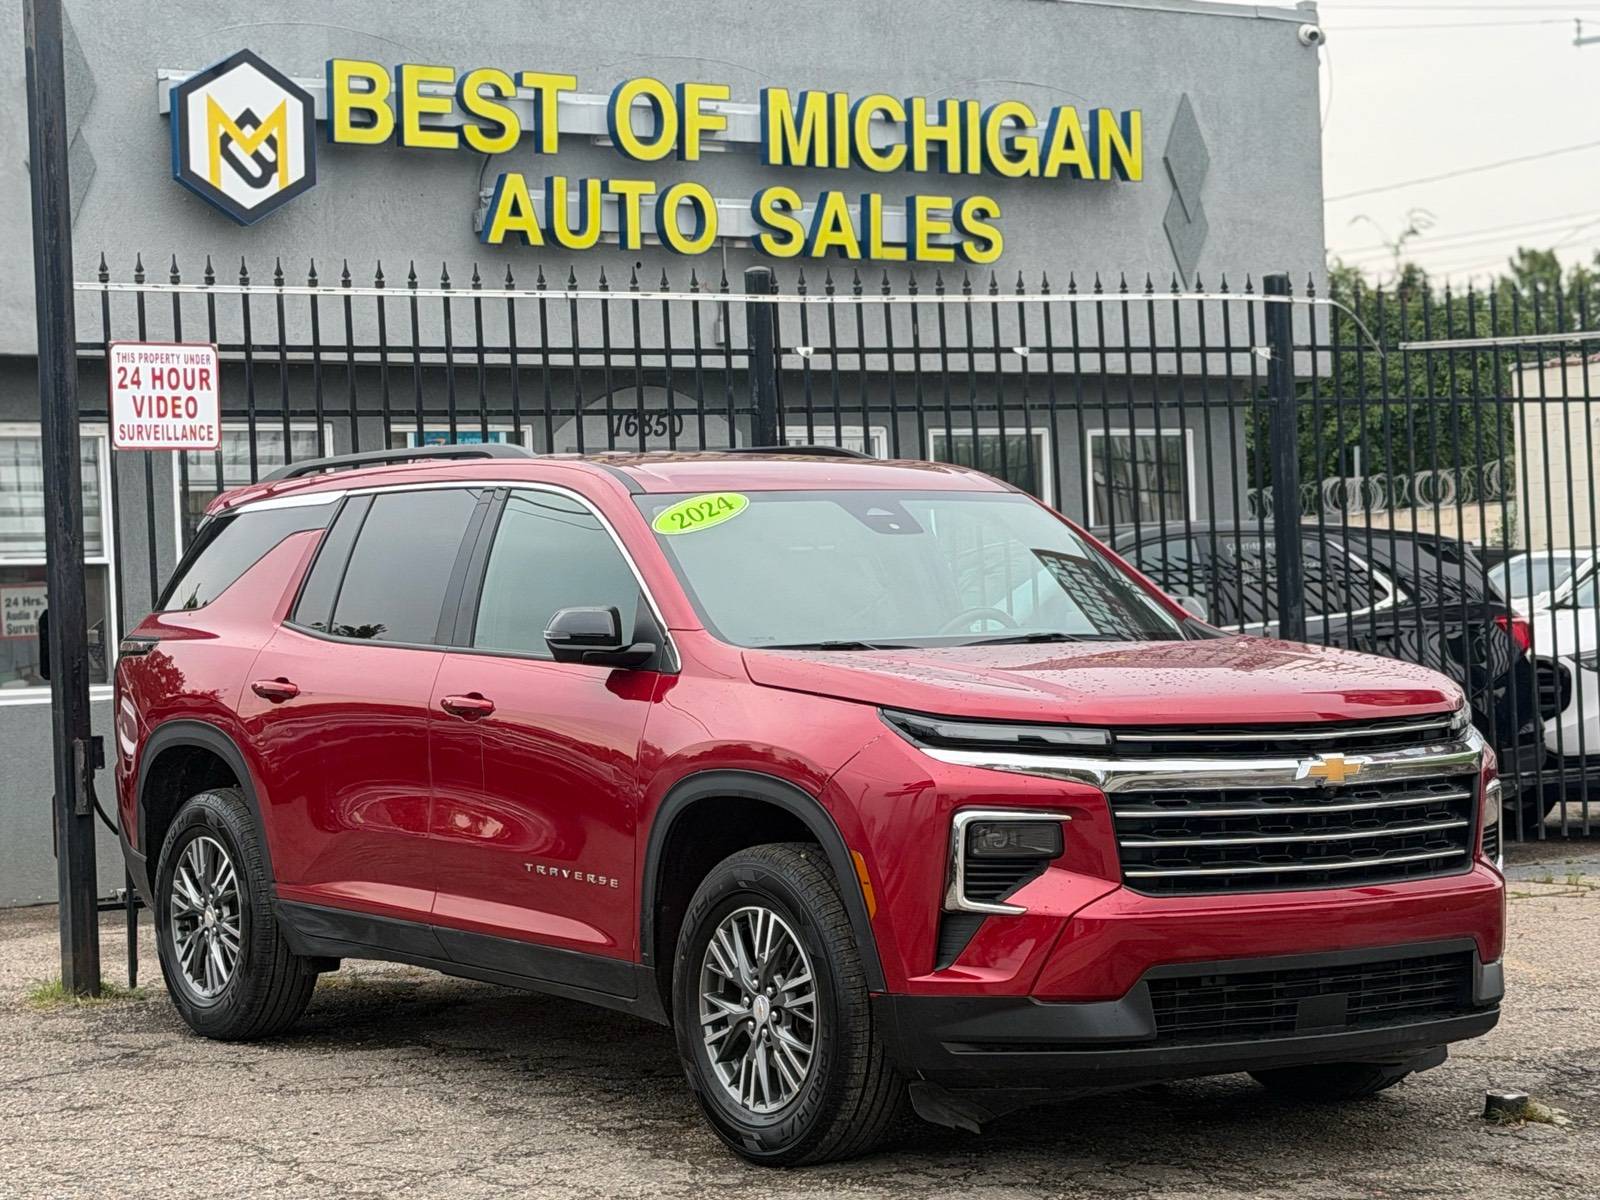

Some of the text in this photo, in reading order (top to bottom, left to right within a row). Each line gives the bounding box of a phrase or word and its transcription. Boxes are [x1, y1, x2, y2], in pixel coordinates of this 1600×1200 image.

[327, 58, 1143, 183] BEST OF MICHIGAN
[480, 172, 1004, 265] AUTO SALES
[116, 352, 211, 366] THIS PROPERTY UNDER
[117, 366, 211, 391] 24 HOUR
[132, 395, 198, 419] VIDEO
[119, 424, 214, 441] SURVEILLANCE
[670, 496, 734, 530] 2024
[5, 597, 19, 608] 24
[524, 862, 619, 888] TRAVERSE
